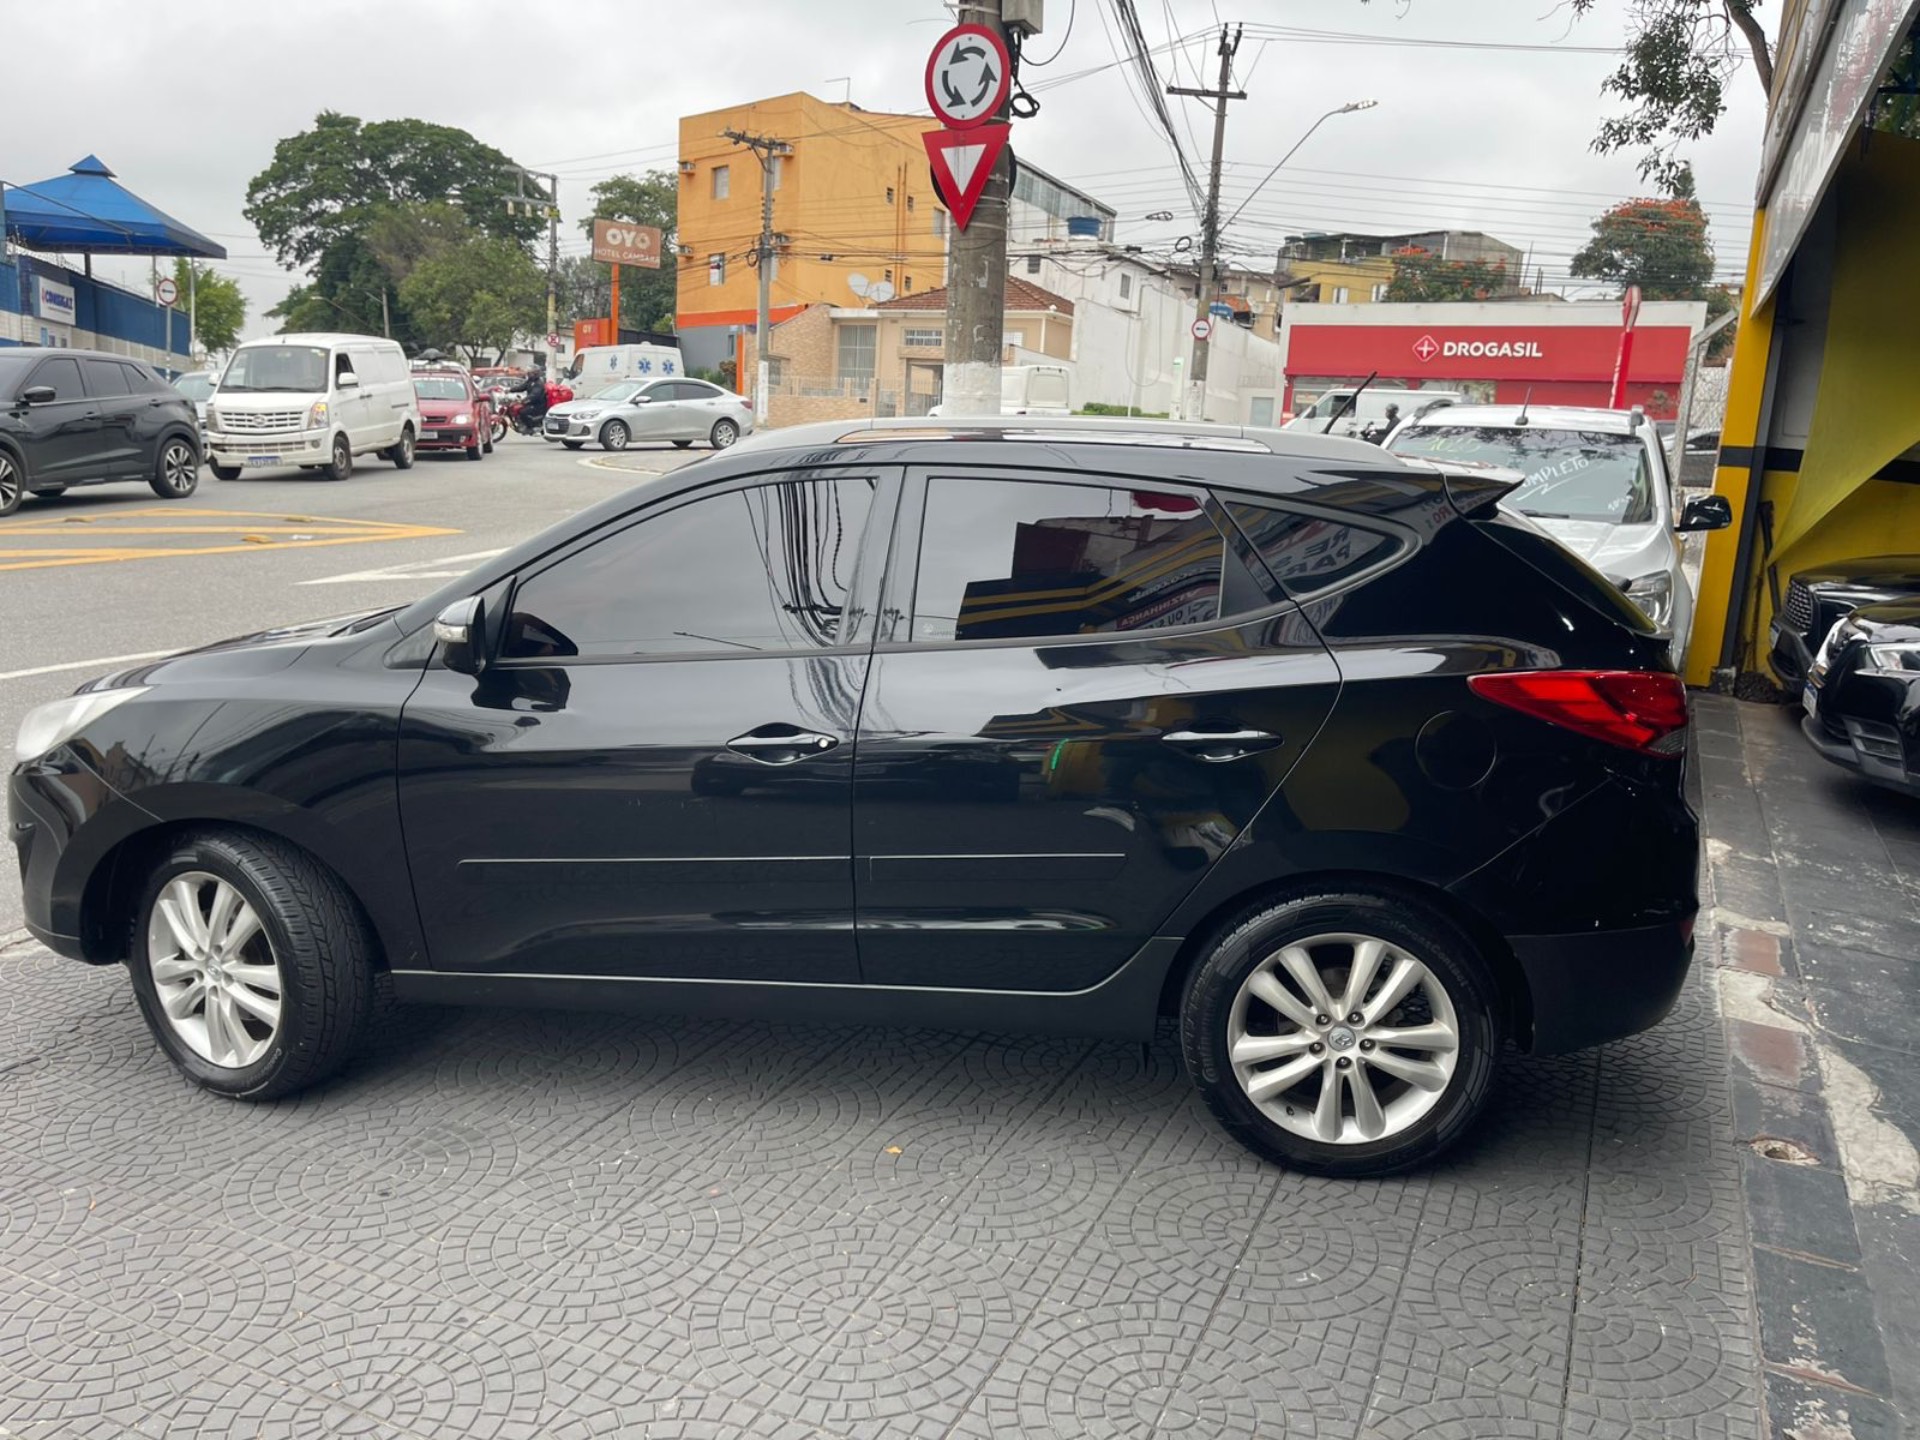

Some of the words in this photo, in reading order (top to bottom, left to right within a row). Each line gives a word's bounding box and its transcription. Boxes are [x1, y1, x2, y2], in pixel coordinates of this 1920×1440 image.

[606, 228, 651, 250] OYO
[594, 247, 621, 259] HOTEL
[1443, 341, 1543, 358] DROGASIL
[1522, 454, 1589, 488] OMPLETO
